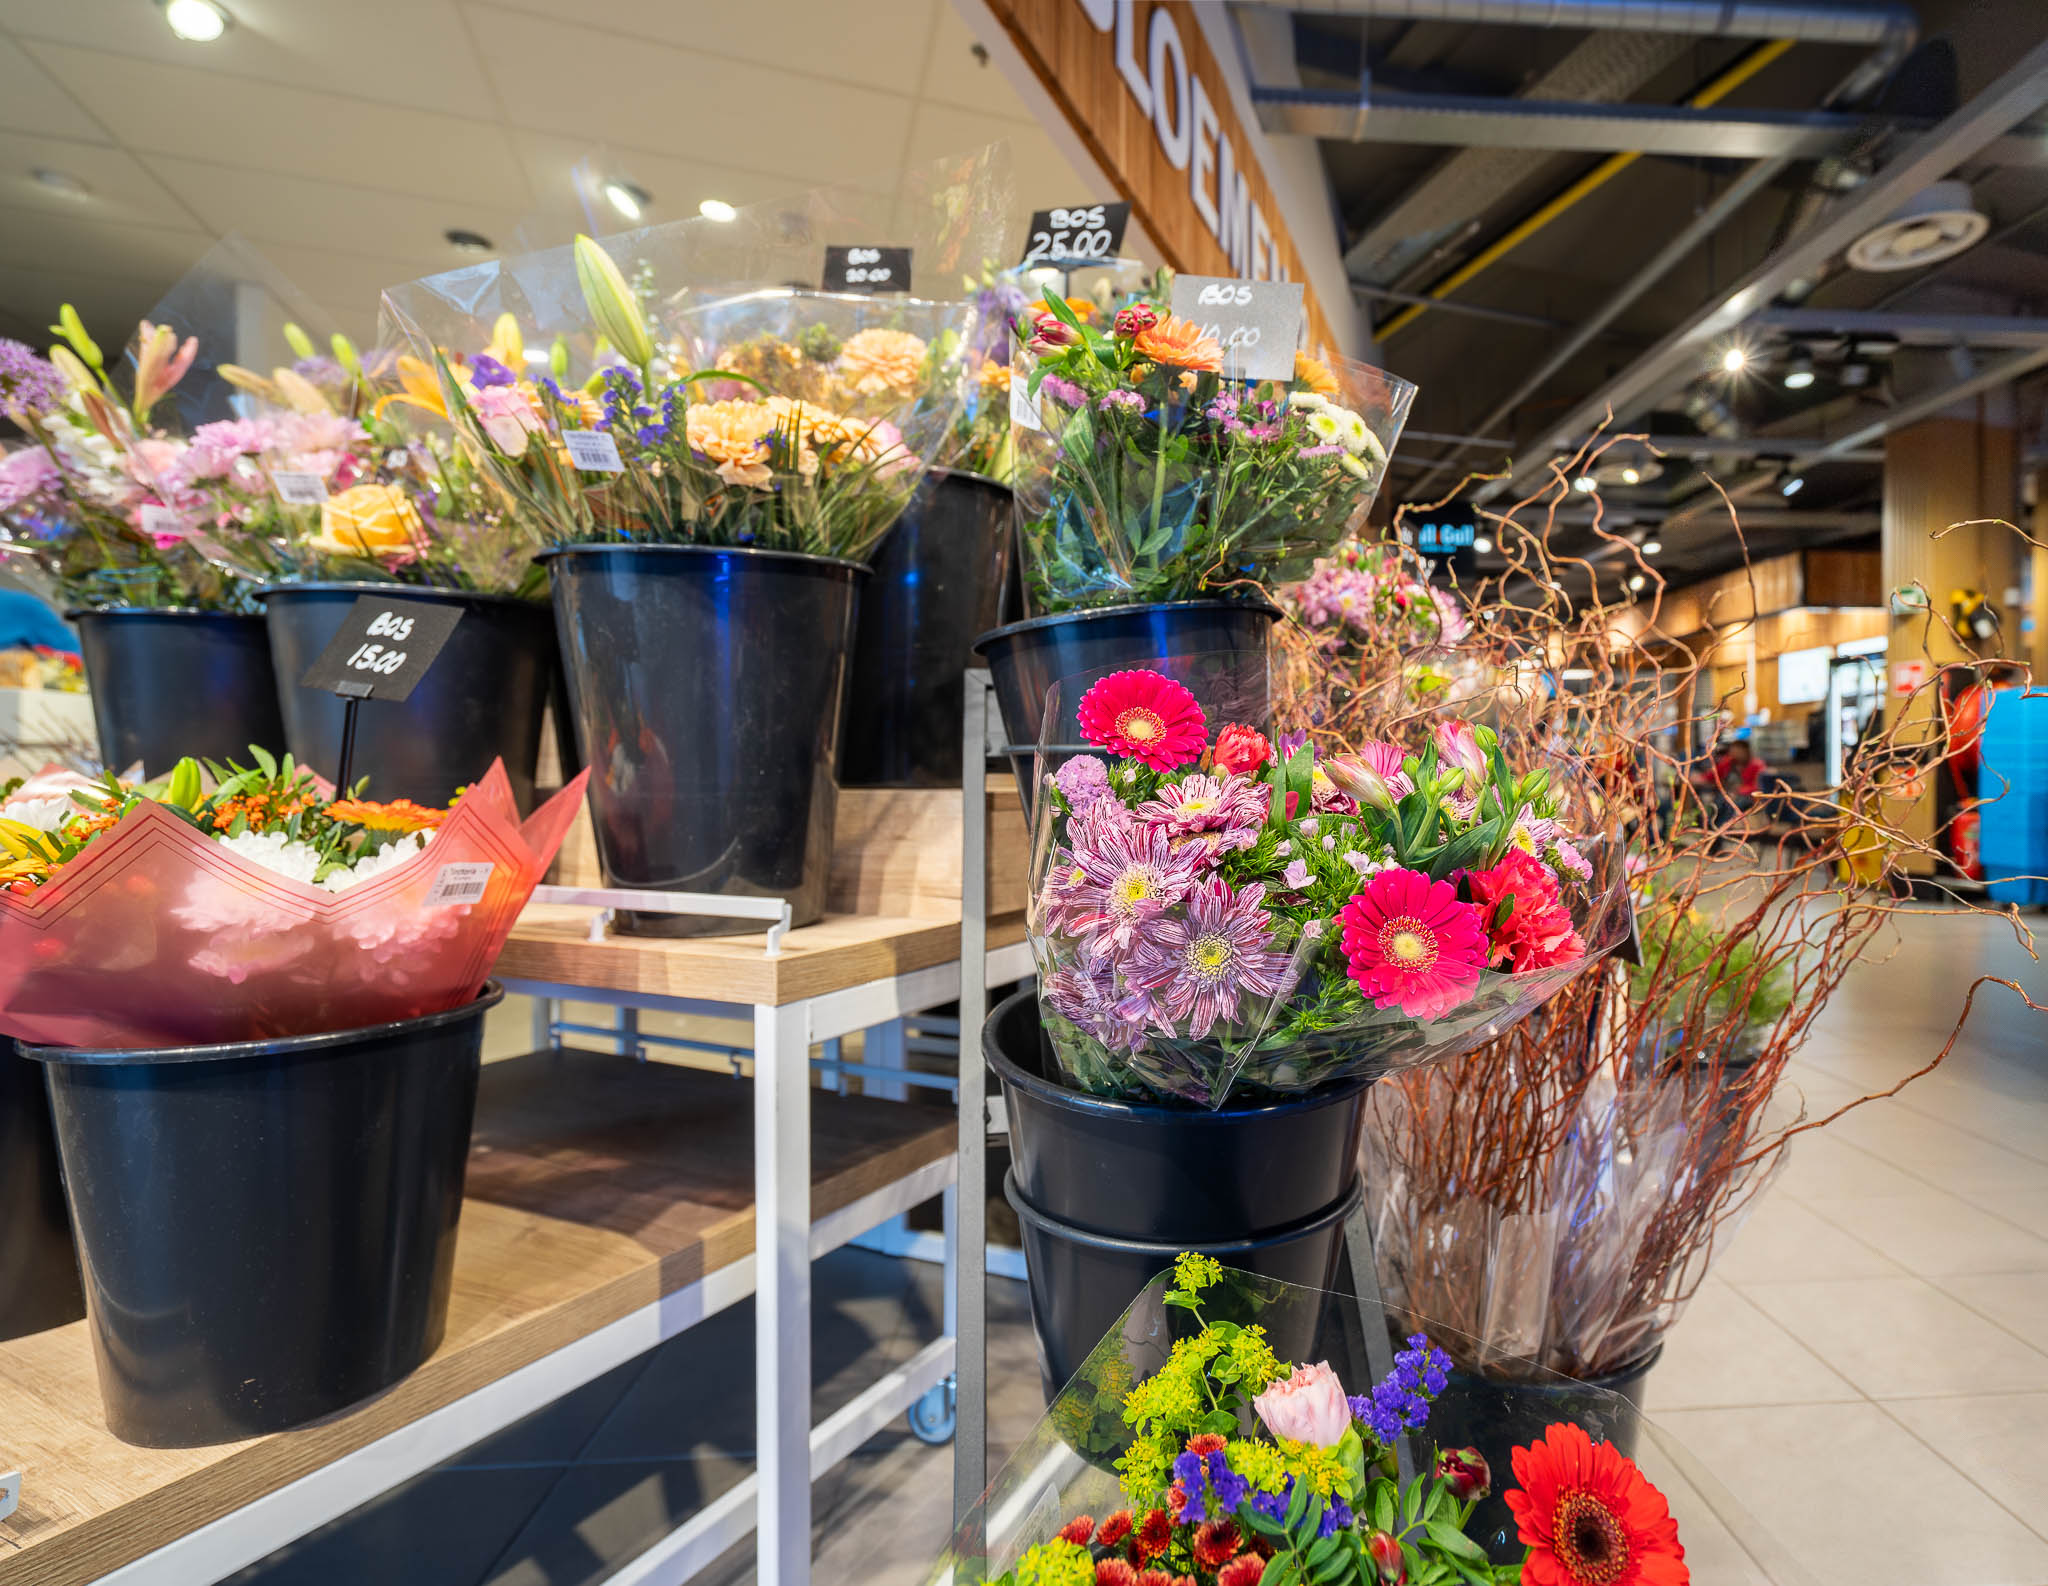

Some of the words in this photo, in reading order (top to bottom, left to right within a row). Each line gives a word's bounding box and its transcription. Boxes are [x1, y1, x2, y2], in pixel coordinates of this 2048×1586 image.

[1049, 205, 1106, 229] BOS
[1197, 283, 1253, 306] BOS
[365, 611, 415, 641] BOS
